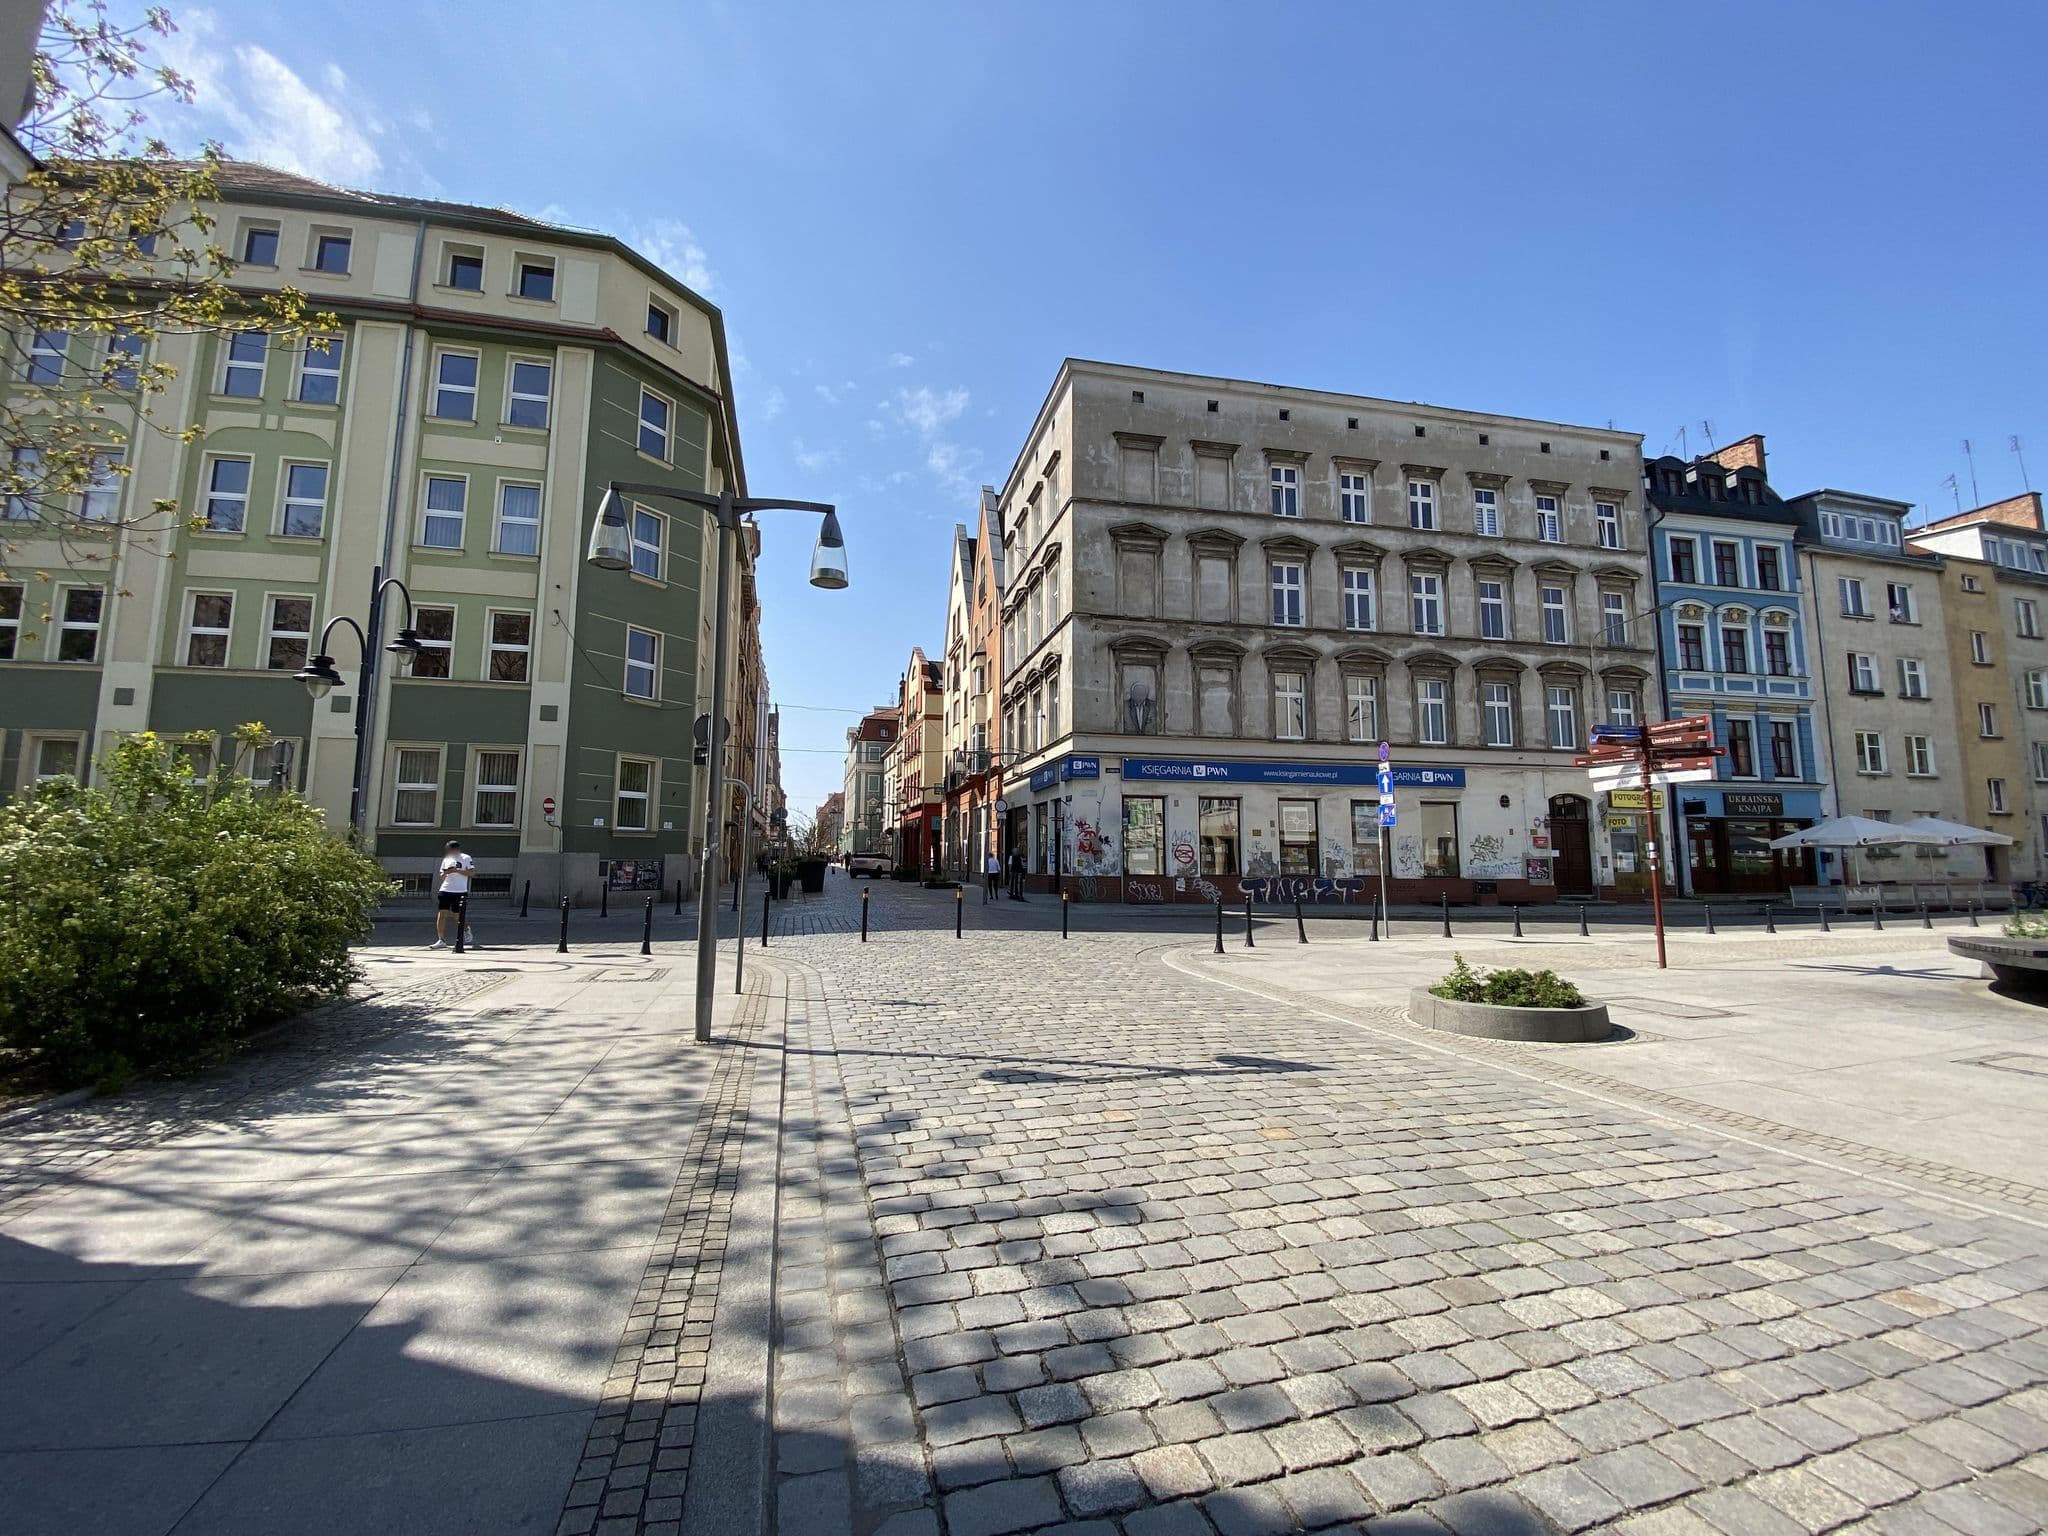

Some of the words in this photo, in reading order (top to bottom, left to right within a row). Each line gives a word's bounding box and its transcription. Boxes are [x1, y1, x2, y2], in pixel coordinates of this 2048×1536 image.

[1651, 736, 1682, 745] Uniwersytet
[1082, 760, 1097, 769] PWN
[1141, 764, 1192, 776] KSIĘGARNIA
[1206, 766, 1228, 777] PWN
[1434, 773, 1454, 782] PWN
[1738, 804, 1772, 814] KNAJPA
[1608, 818, 1627, 826] FOTO
